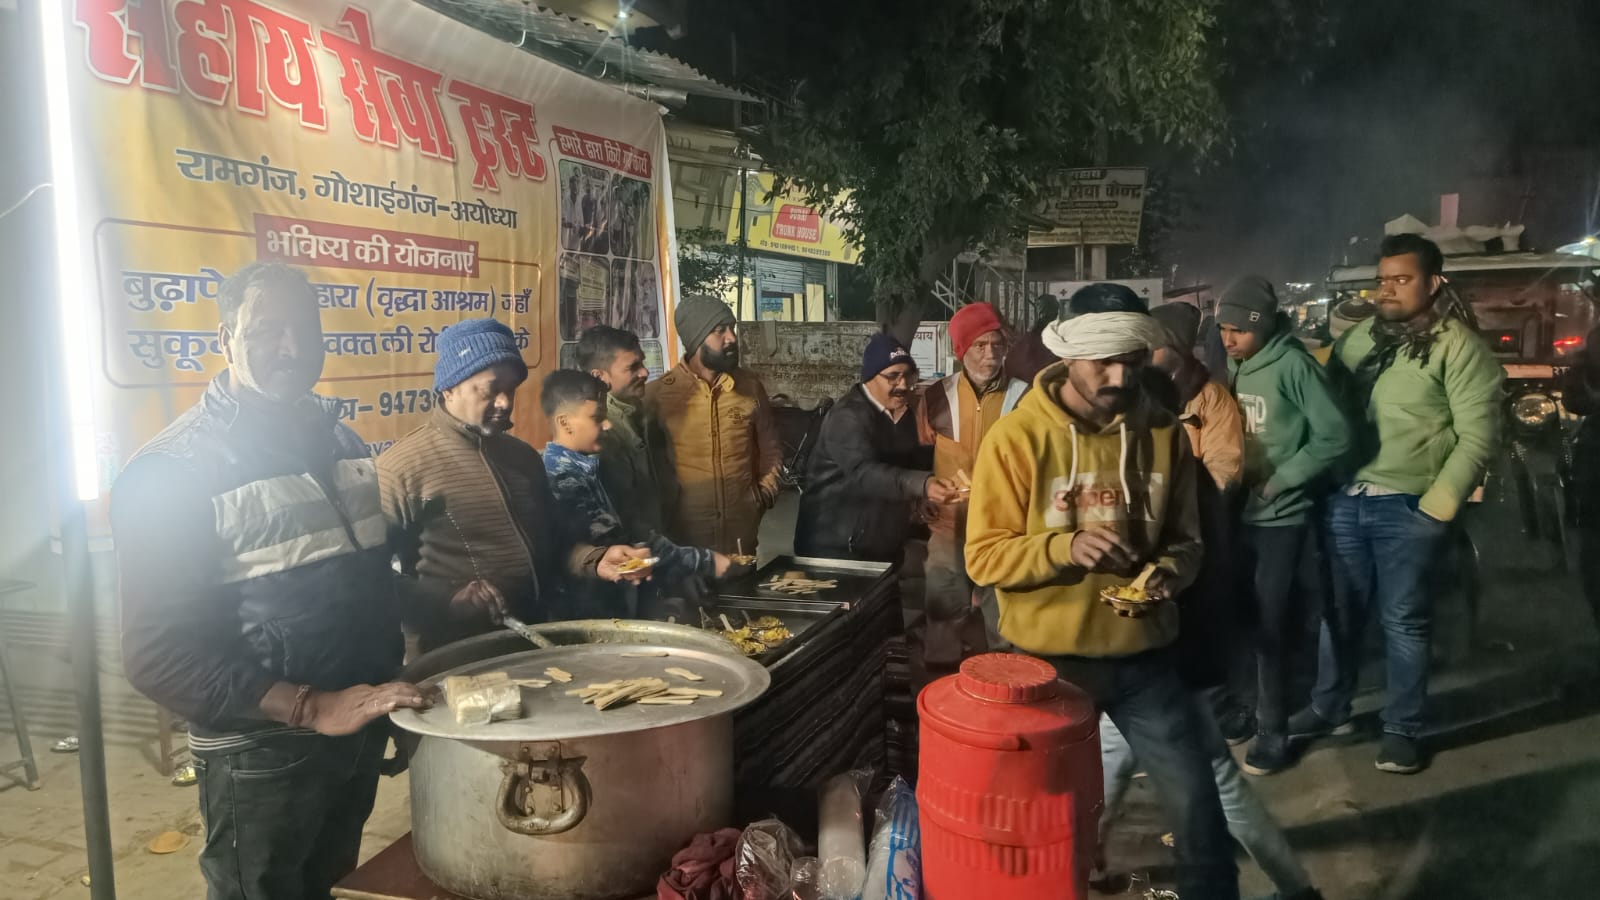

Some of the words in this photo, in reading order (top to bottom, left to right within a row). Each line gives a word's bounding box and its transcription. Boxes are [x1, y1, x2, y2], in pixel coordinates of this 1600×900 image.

[319, 6, 457, 162] सेवा
[448, 78, 549, 192] ट्रस्ट
[556, 132, 584, 157] हमारे
[176, 149, 307, 201] रामगंज,
[266, 224, 349, 261] भविष्य
[353, 234, 390, 265] की
[394, 240, 475, 274] योजनाएं
[380, 326, 413, 354] की
